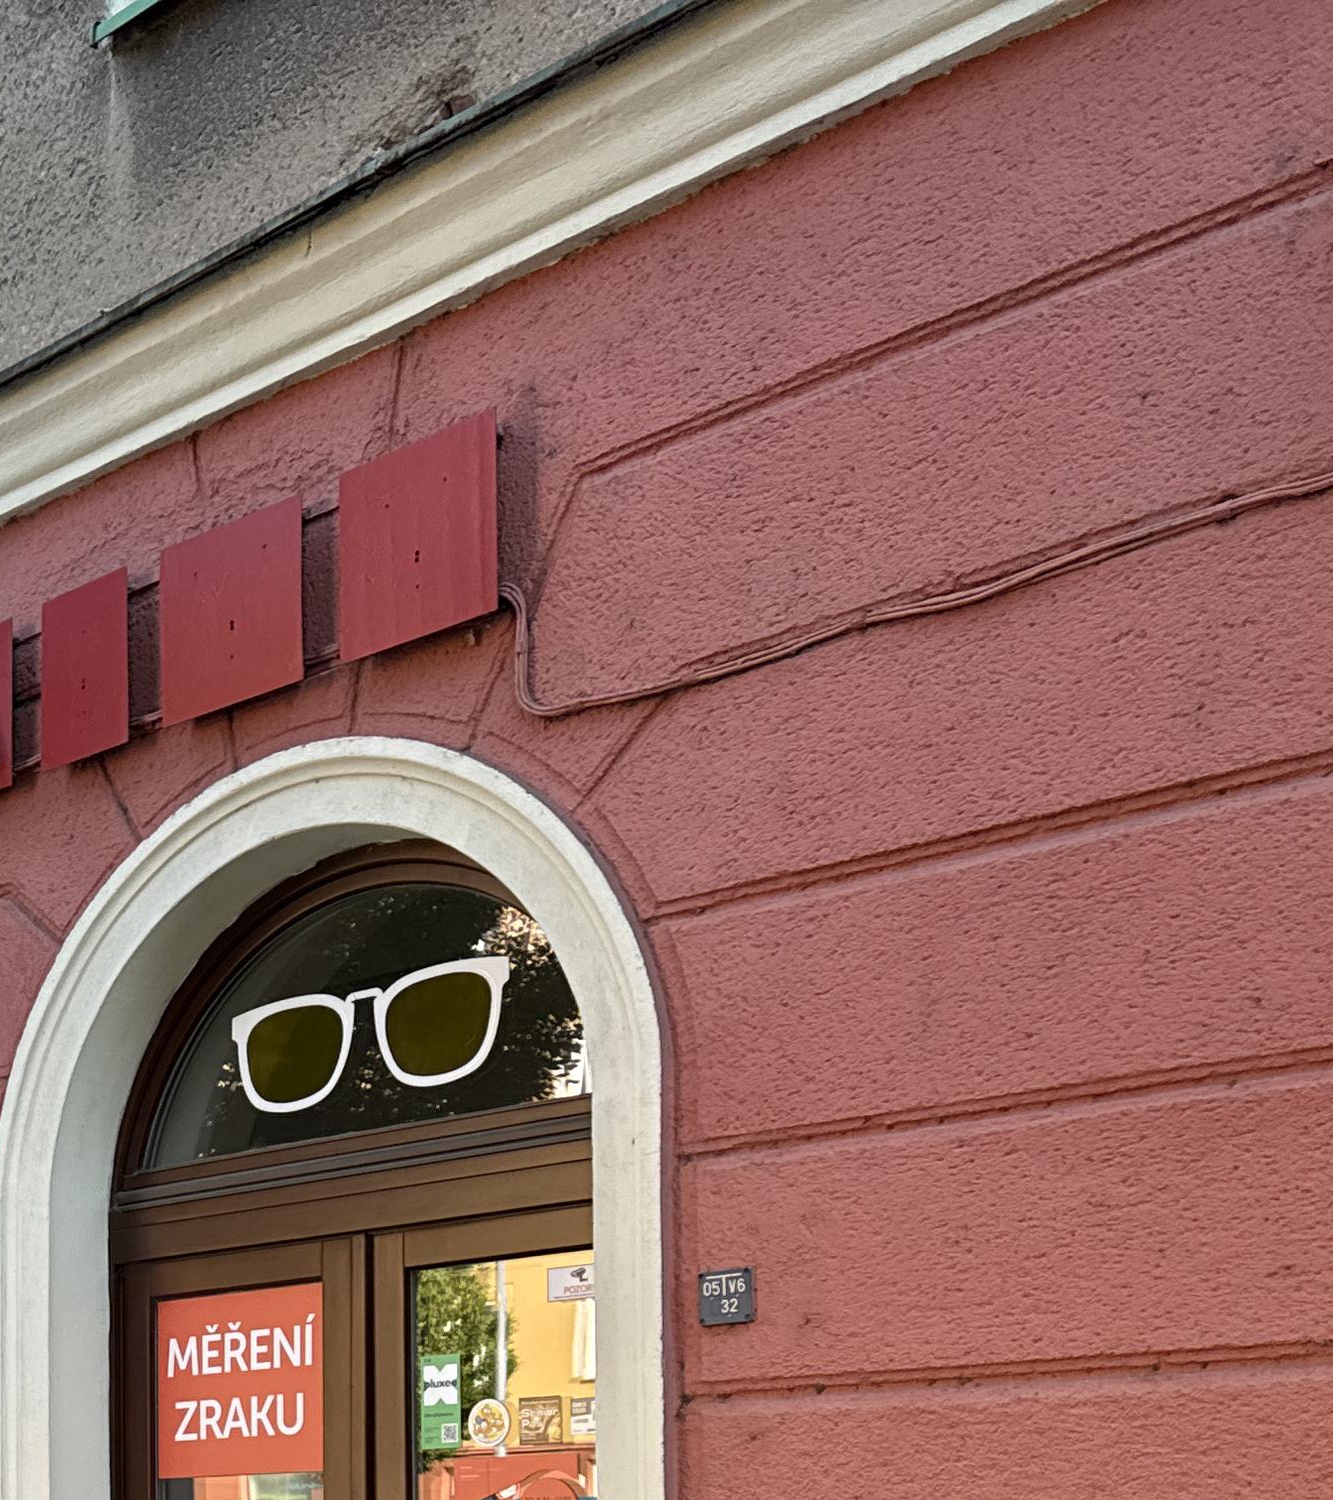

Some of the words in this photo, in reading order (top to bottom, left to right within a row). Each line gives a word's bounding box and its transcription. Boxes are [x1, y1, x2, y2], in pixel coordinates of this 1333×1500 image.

[720, 1298, 739, 1314] 32
[167, 1313, 317, 1378] MĚŘENÍ
[424, 1378, 458, 1392] pluxee
[174, 1392, 304, 1442] ZRAKU
